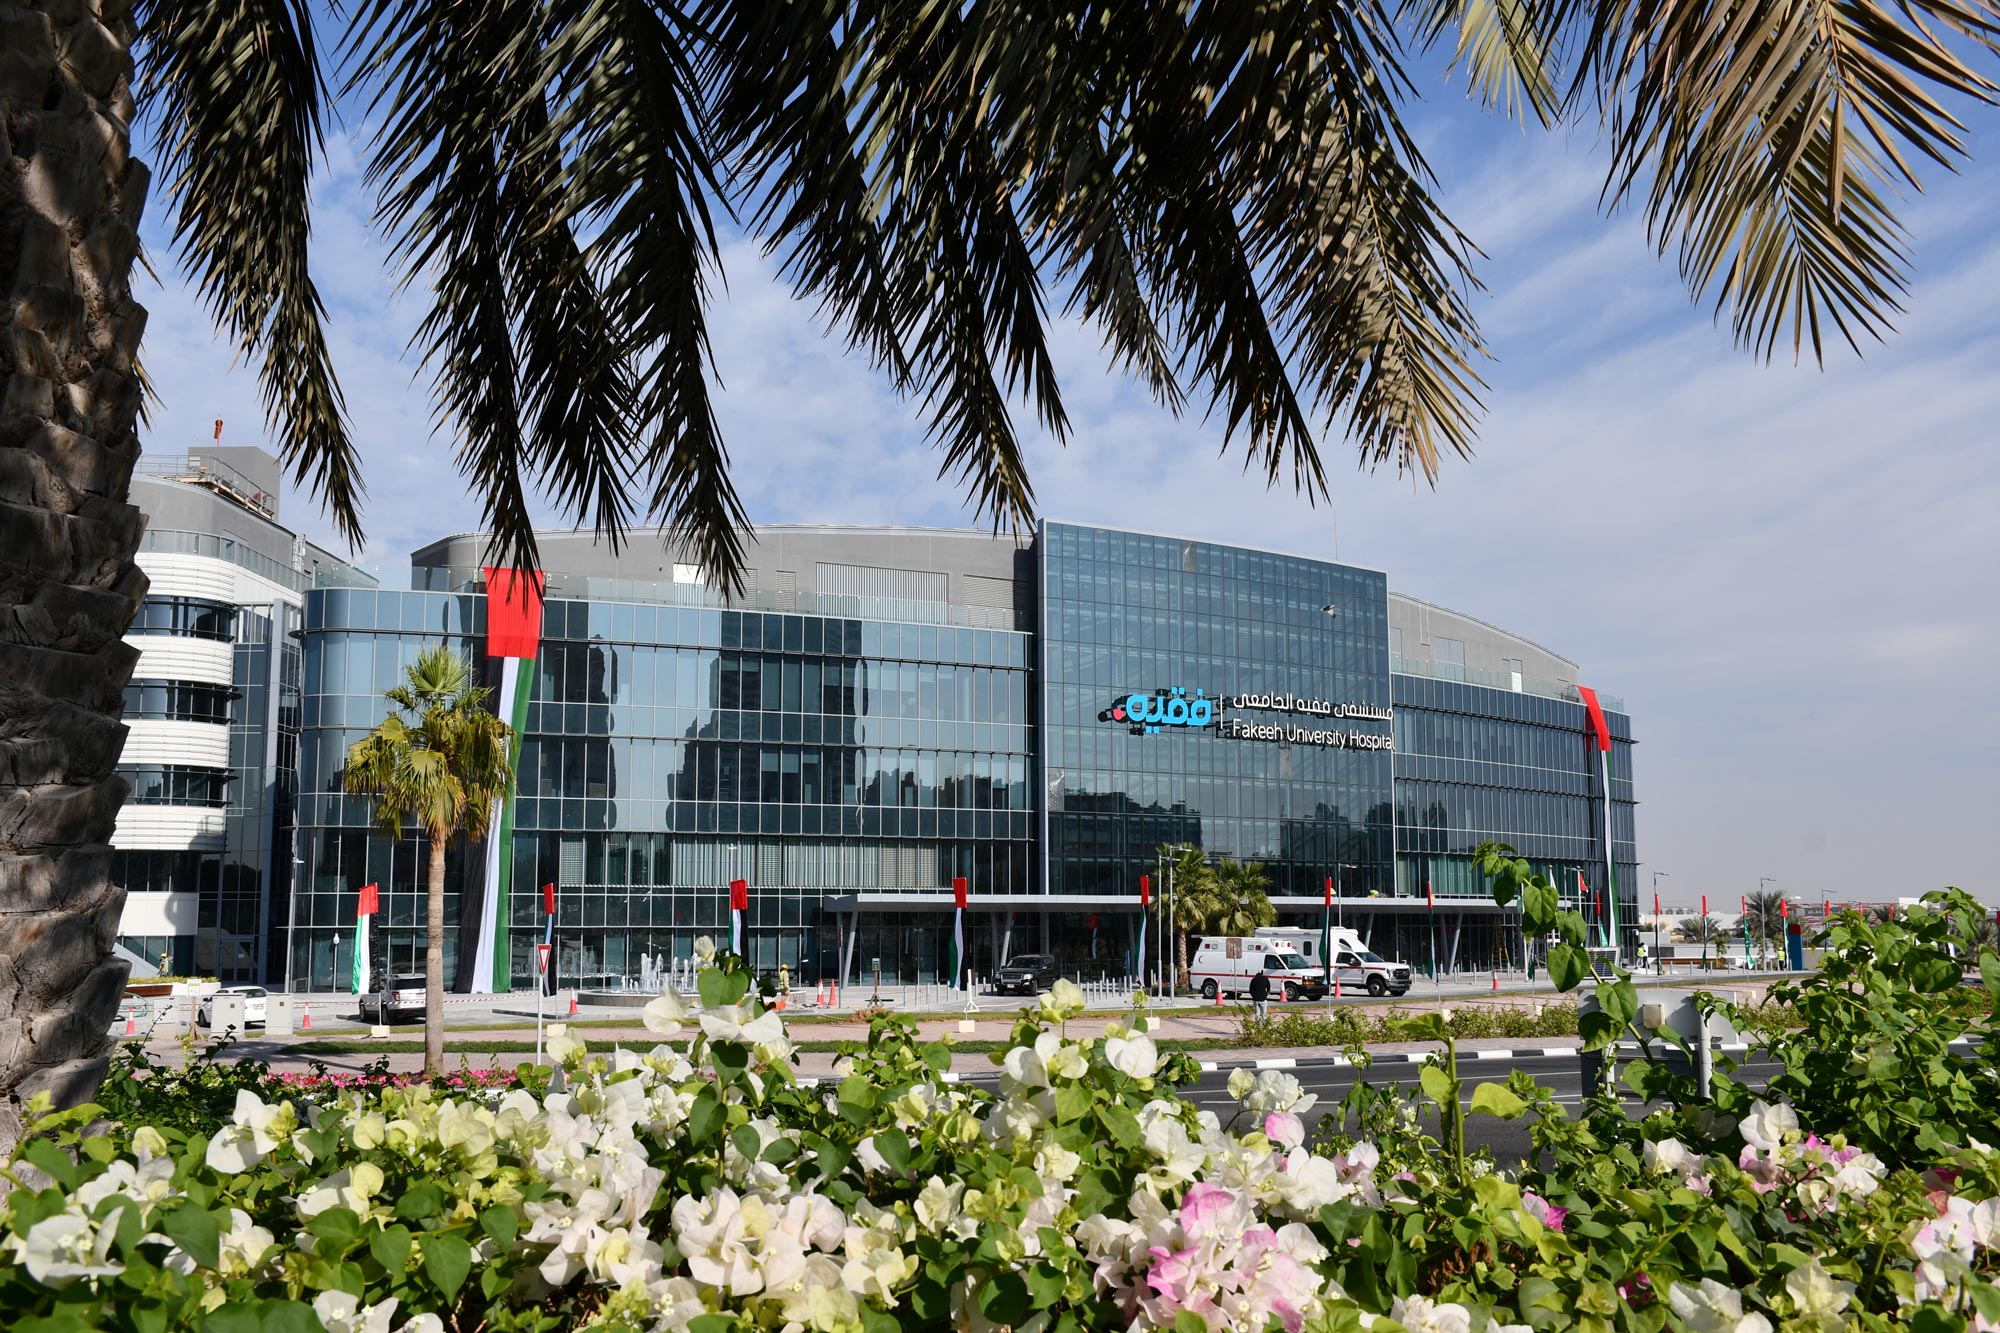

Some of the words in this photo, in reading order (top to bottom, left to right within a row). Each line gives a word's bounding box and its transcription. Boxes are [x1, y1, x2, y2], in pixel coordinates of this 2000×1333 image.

[1126, 687, 1213, 734] فقيه
[1233, 691, 1293, 712] الجامعي
[1296, 697, 1331, 715] فقيه
[1334, 699, 1393, 720] مستشفى
[1233, 718, 1283, 741] Fakeeh
[1286, 723, 1346, 750] University
[1349, 729, 1396, 752] Hospital
